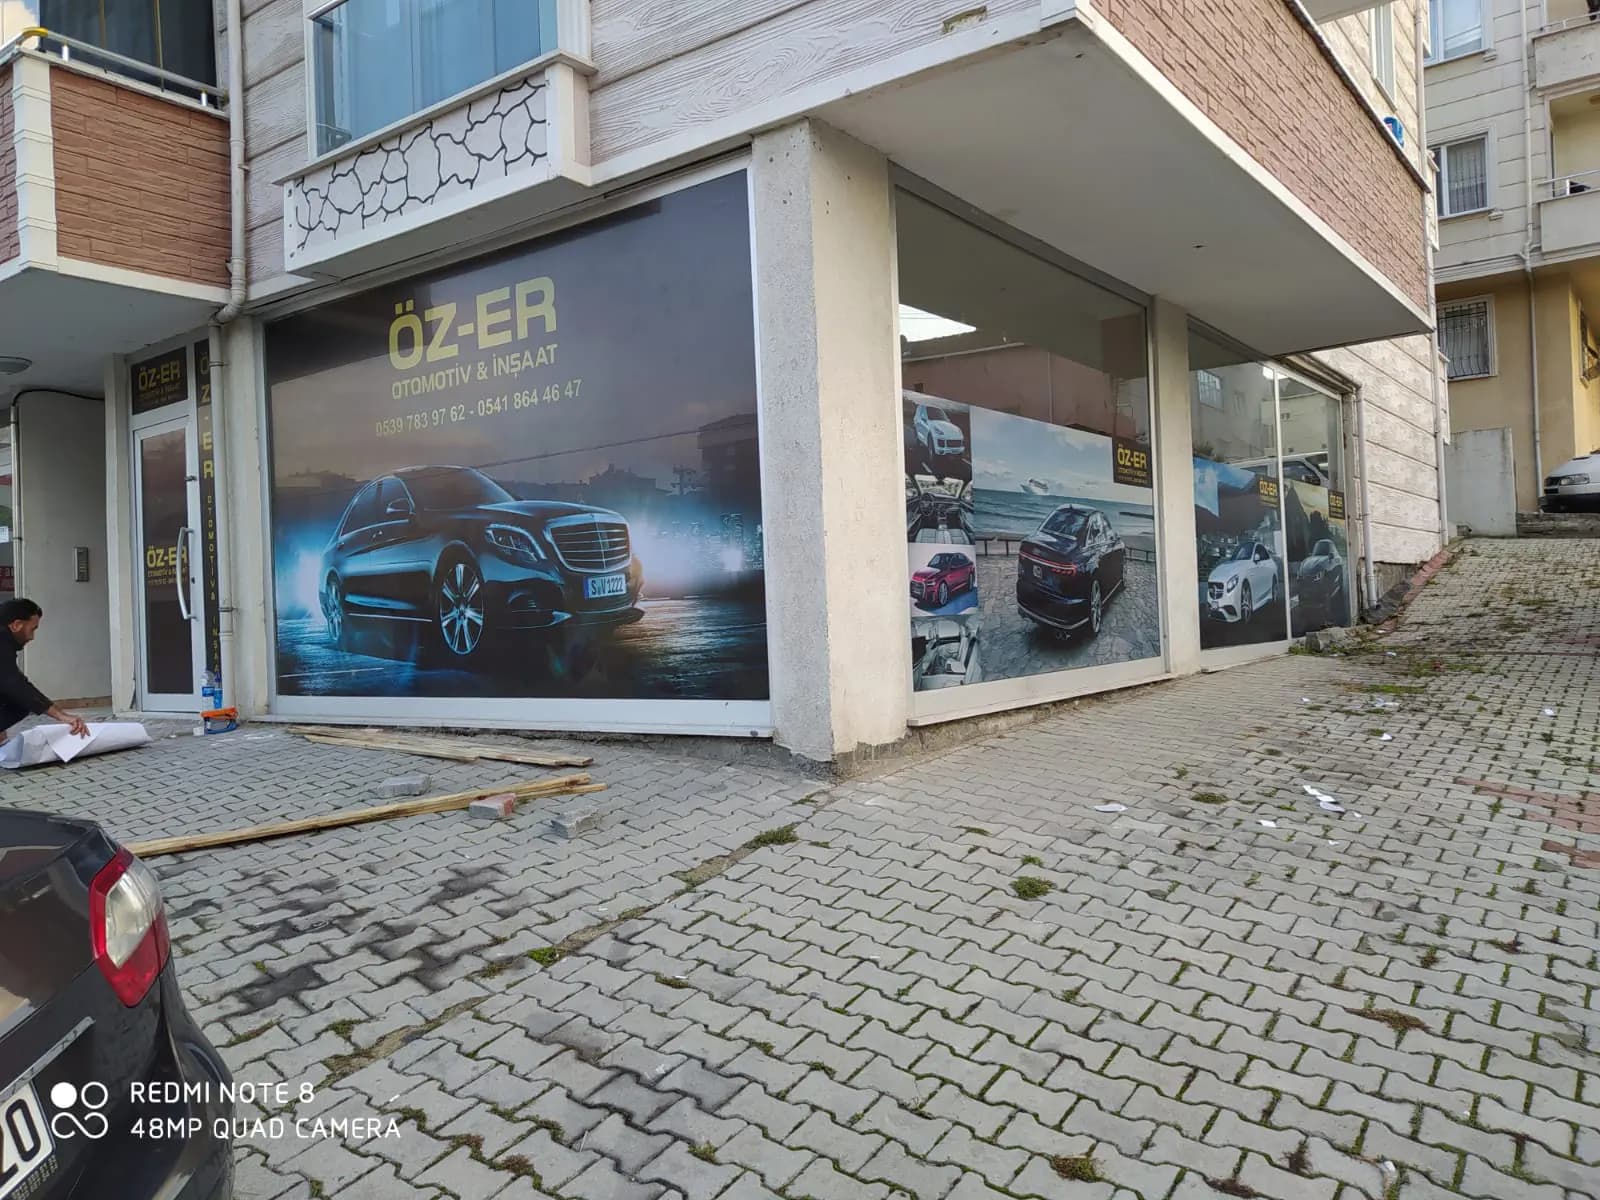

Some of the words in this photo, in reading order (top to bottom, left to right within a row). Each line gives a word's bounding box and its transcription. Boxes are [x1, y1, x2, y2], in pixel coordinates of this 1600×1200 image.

[389, 276, 557, 370] ÖZ-ER
[391, 362, 473, 400] OTOMOTİV
[477, 361, 488, 380] &
[492, 344, 558, 378] İNŞAAT
[375, 417, 403, 437] 0539
[407, 411, 429, 431] 783
[432, 408, 446, 427] 97
[450, 404, 465, 422] 62
[478, 396, 508, 417] 0541
[513, 388, 538, 410] 864
[543, 383, 560, 403] 46
[565, 378, 583, 398] 47
[1117, 443, 1148, 469] ÖZ-ER
